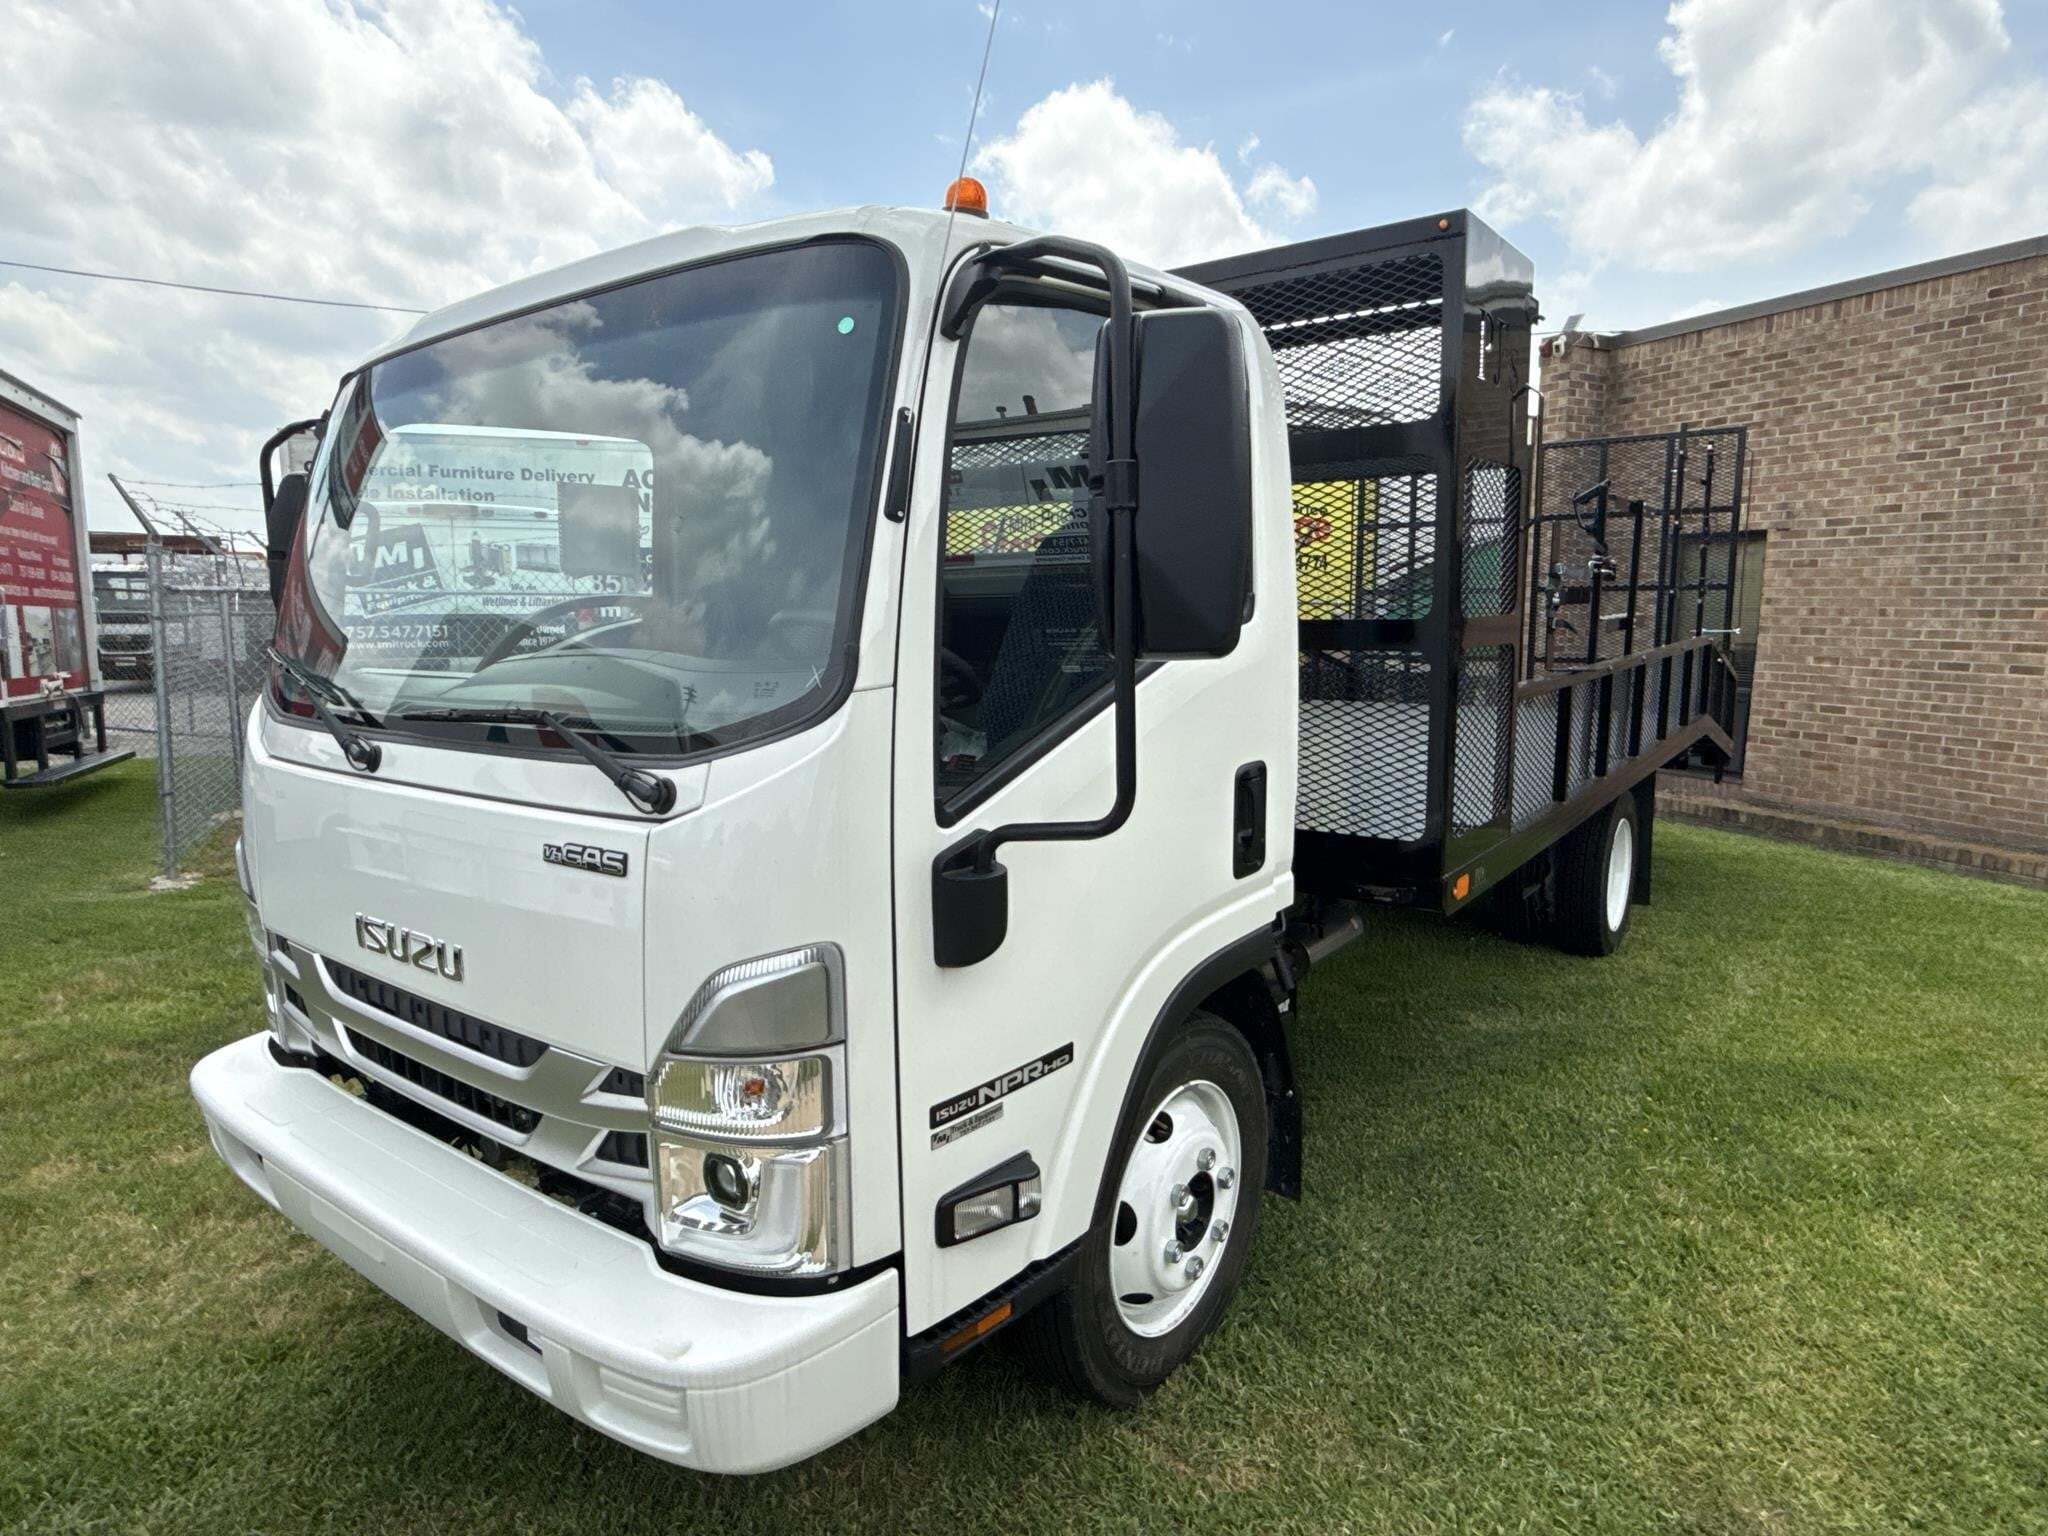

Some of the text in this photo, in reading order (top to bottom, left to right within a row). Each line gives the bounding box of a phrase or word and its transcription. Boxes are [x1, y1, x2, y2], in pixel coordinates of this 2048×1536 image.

[387, 485, 496, 502] Installation
[428, 464, 515, 480] Furniture
[520, 468, 596, 484] Delivery
[355, 911, 465, 984] ISUZU
[936, 1095, 977, 1122] ISUZU
[978, 1060, 1043, 1105] NPR
